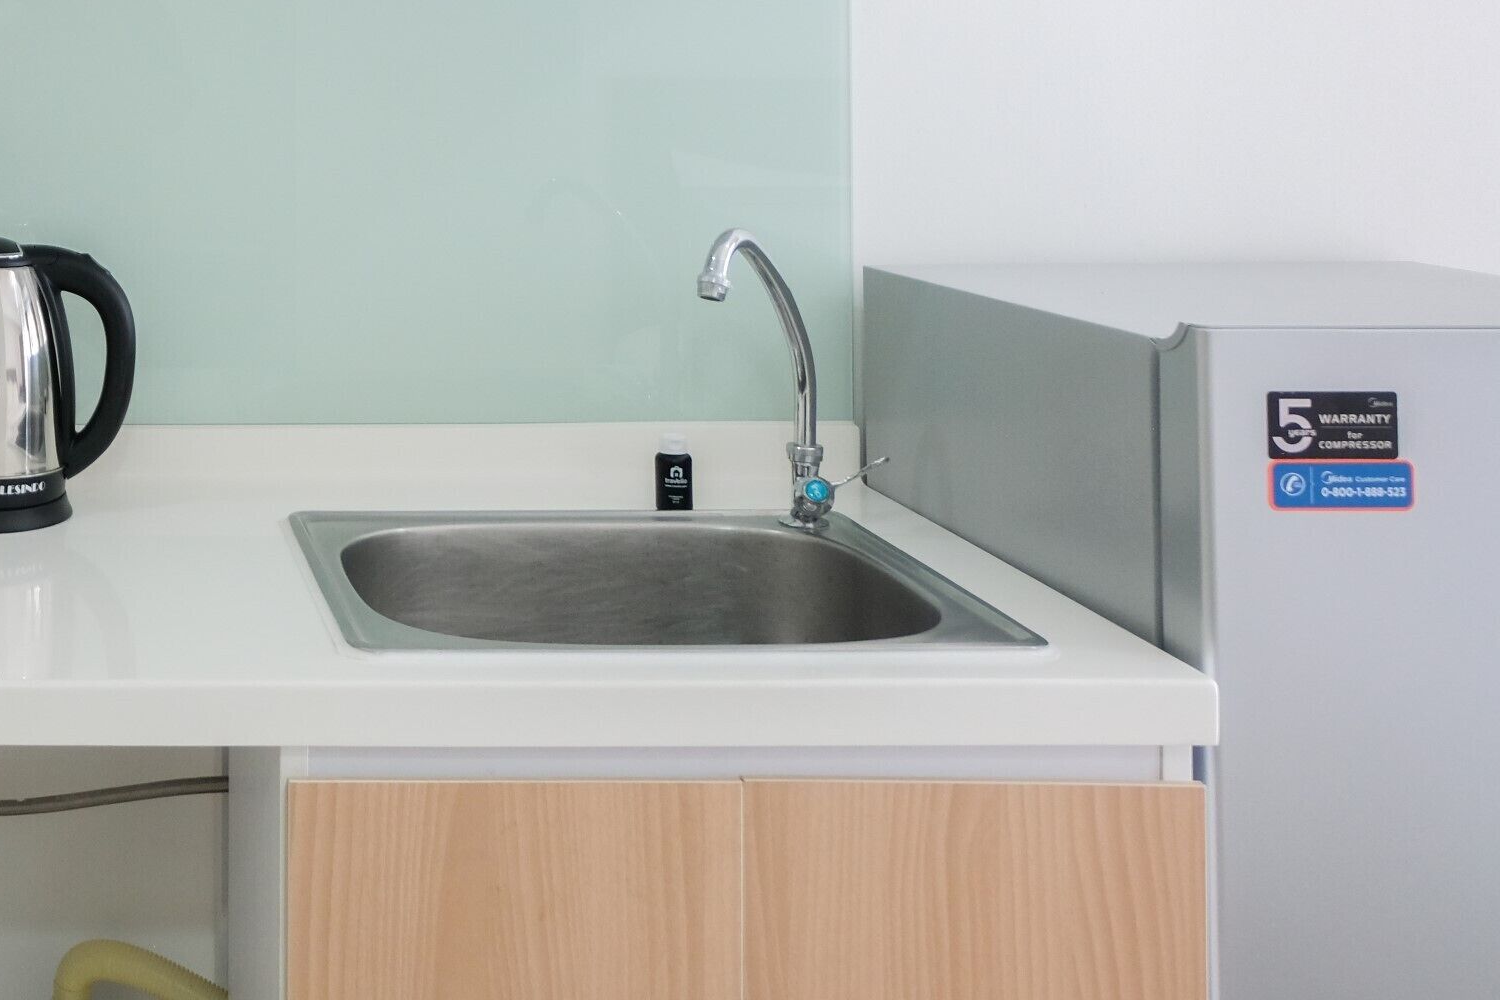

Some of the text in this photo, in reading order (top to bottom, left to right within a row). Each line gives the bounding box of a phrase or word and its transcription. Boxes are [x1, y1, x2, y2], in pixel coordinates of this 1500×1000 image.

[1318, 413, 1392, 425] WARRANTY
[1272, 398, 1314, 453] 5
[1287, 428, 1317, 438] years
[1347, 430, 1363, 439] for
[1318, 440, 1393, 450] COMPRESSOR
[0, 480, 46, 496] LESINDO
